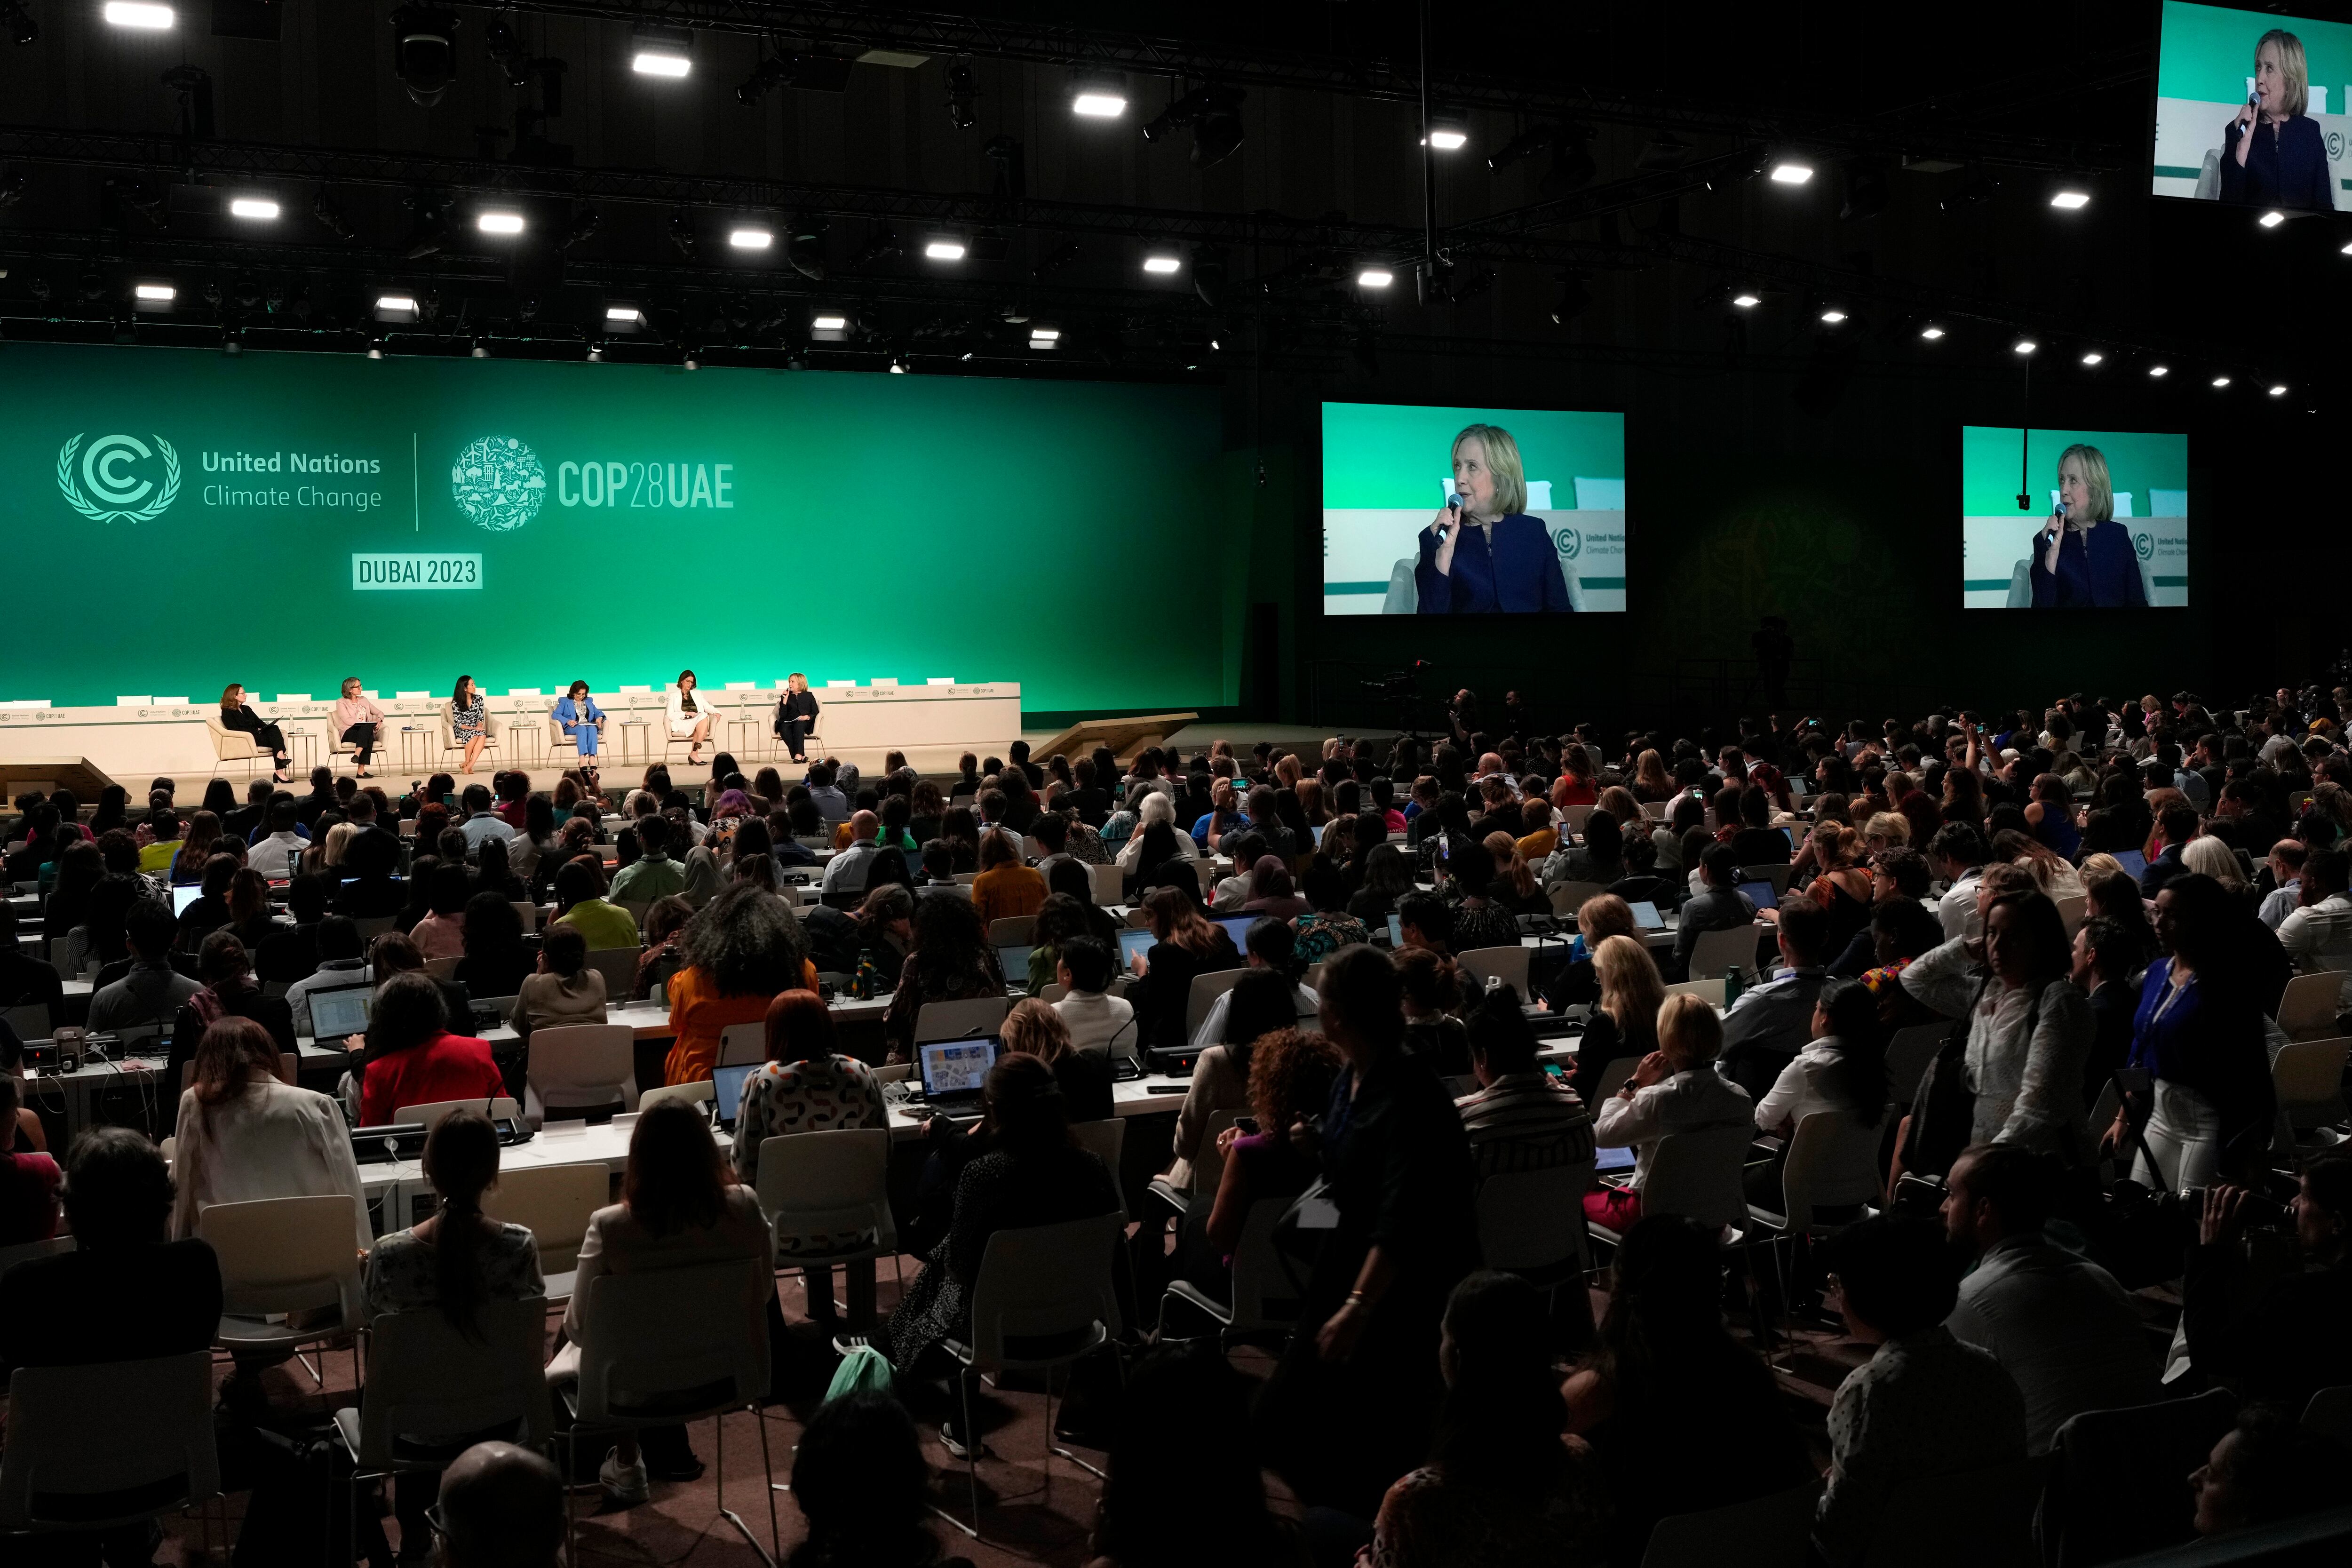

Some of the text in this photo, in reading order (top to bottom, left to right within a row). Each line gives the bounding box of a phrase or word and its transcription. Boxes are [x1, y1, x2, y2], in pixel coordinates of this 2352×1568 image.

[202, 451, 381, 474] United Nations
[558, 461, 734, 508] COP28UAE
[203, 486, 382, 512] Climate Change
[1586, 533, 1607, 542] United
[358, 559, 477, 583] DUBAI 2023
